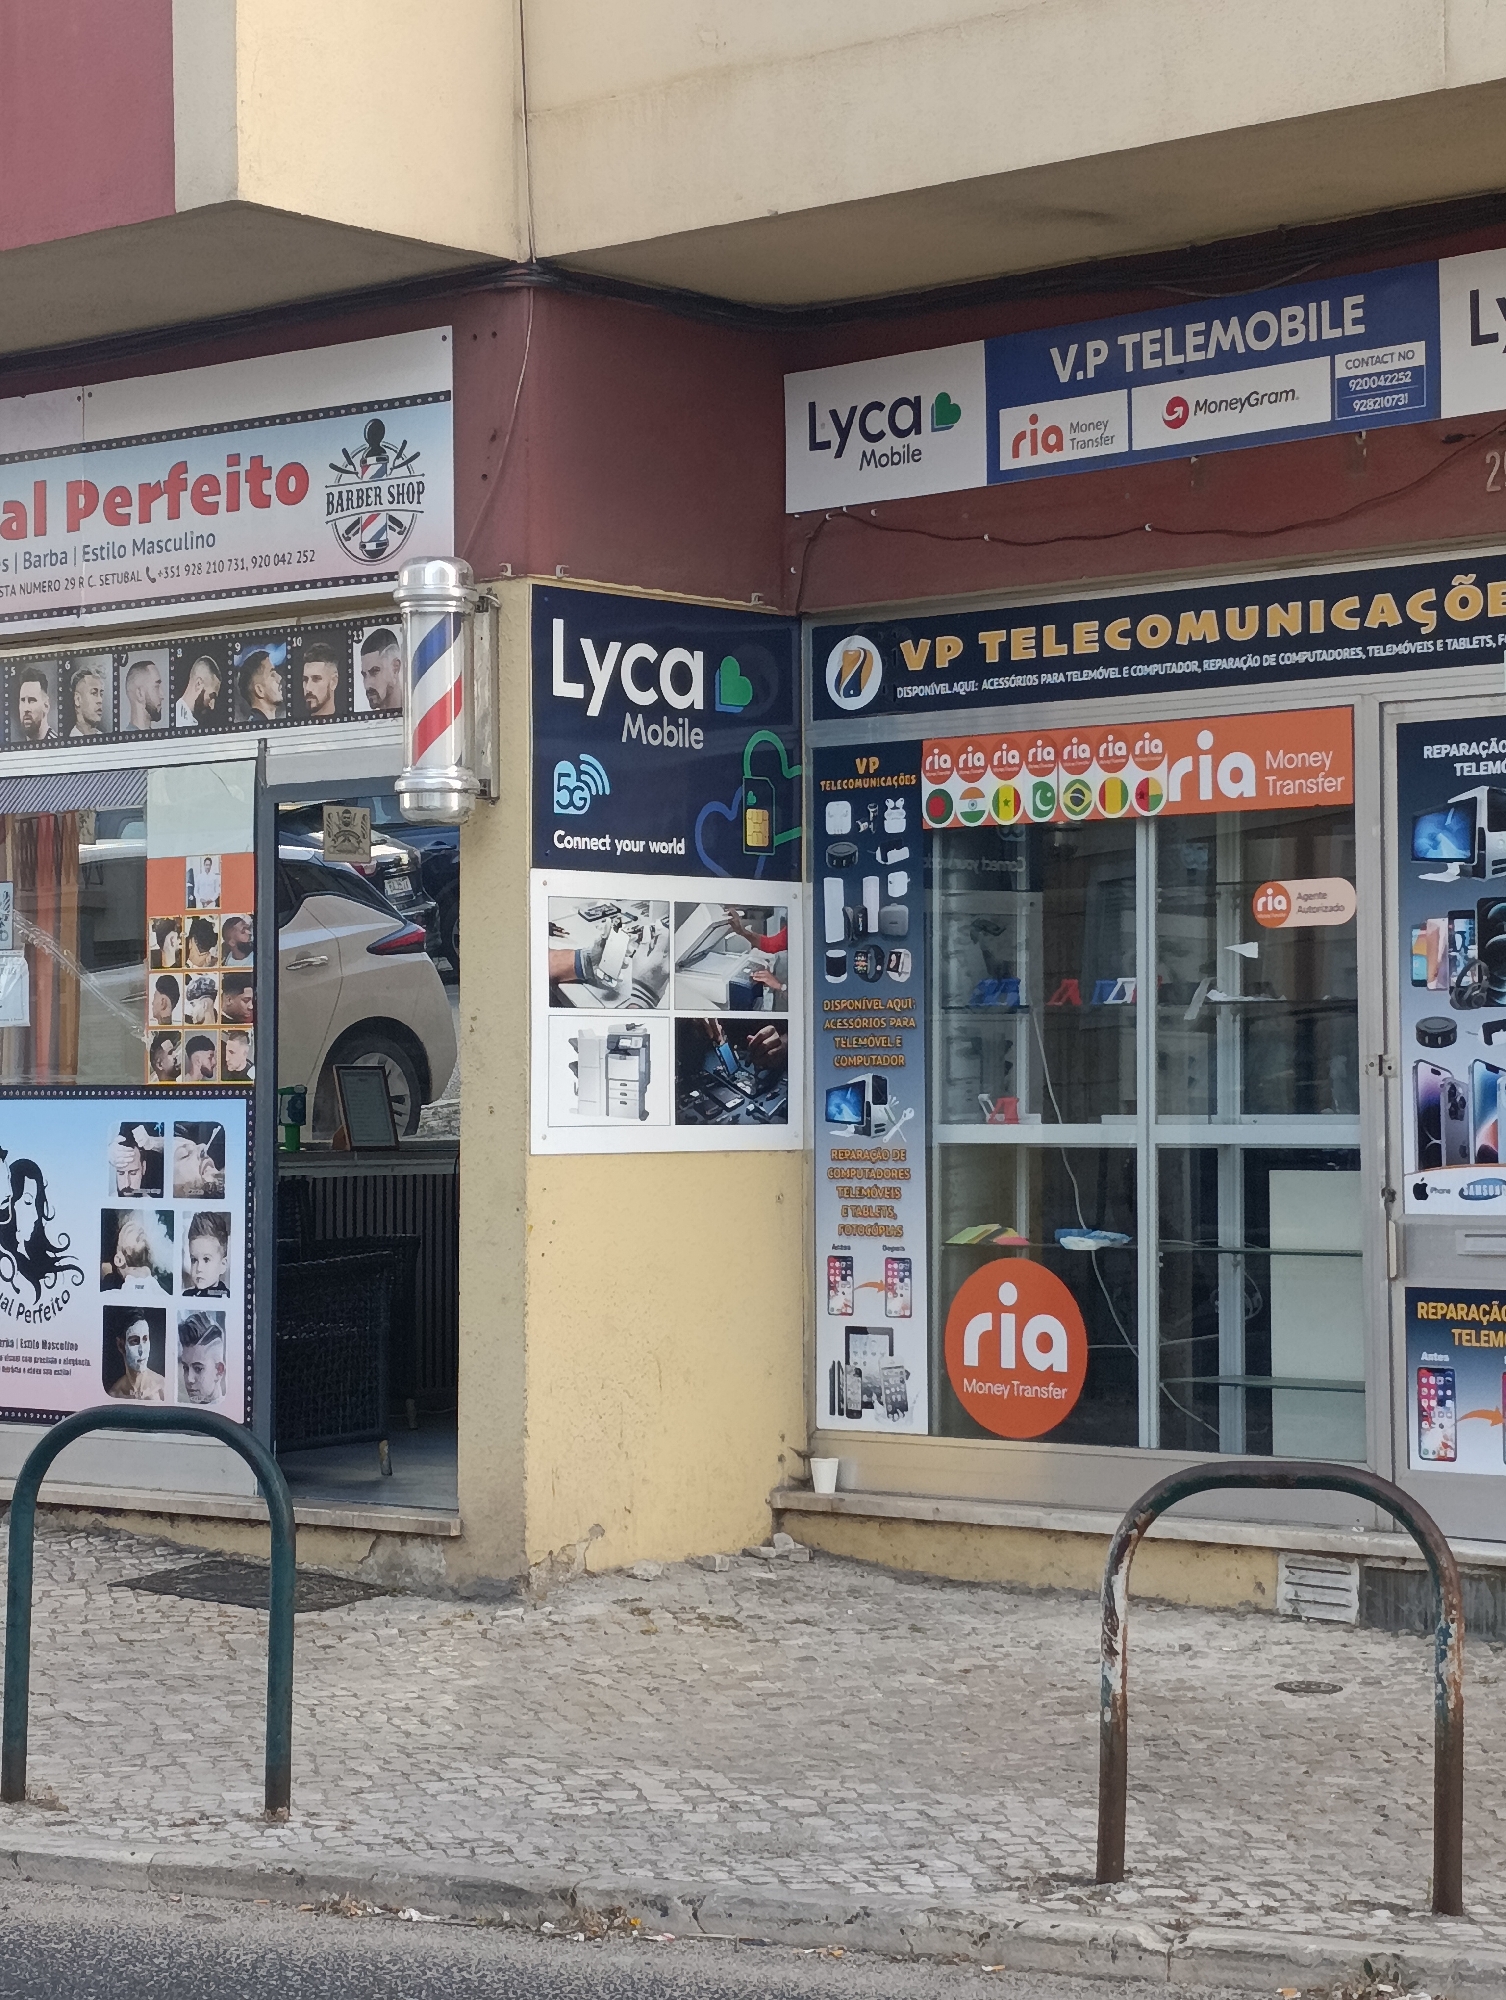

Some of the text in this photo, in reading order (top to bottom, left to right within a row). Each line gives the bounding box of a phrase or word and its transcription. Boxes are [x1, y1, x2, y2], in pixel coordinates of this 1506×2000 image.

[1050, 293, 1365, 383] V.P TELEMOBILE
[1345, 349, 1415, 370] CONTACT NO
[1349, 371, 1412, 391] 920042252
[1352, 392, 1409, 412] 928210731
[808, 395, 922, 459] Lyca
[1011, 413, 1064, 459] ria
[1069, 419, 1109, 434] Money
[1069, 434, 1115, 450] Transfer
[859, 444, 922, 471] Mobile
[1486, 451, 1506, 492] 2
[66, 453, 309, 533] Perfeito
[326, 480, 425, 516] BARBER SHOP
[23, 550, 68, 570] Barba
[82, 541, 127, 562] Estilo
[132, 531, 216, 557] Masculino
[19, 579, 60, 595] NUMERO
[64, 577, 76, 590] 29
[100, 570, 142, 587] SETUBAL
[158, 566, 181, 579] +351
[184, 563, 203, 577] 928
[206, 560, 225, 574] 210
[228, 558, 249, 571] 731,
[251, 555, 270, 568] 920
[273, 552, 292, 567] 042
[296, 550, 315, 563] 252
[235, 642, 241, 652] 9
[292, 636, 302, 647] 10
[353, 630, 363, 641] 11
[121, 654, 127, 664] 7
[899, 635, 964, 671] VP
[65, 661, 71, 670] 6
[552, 618, 704, 717] Lyca
[897, 682, 951, 698] DISPONÍVEL
[952, 680, 978, 695] AQUI:
[981, 674, 1039, 691] ACESSÓRIOS
[1041, 672, 1065, 684] PARA
[1066, 666, 1121, 682] TELEMÓVEL
[1123, 668, 1129, 677] E
[1130, 661, 1201, 677] COMPUTADOR,
[1203, 654, 1260, 671] REPARAÇÃO
[1263, 654, 1276, 666] DE
[1279, 647, 1366, 665] COMPUTADORES,
[1367, 640, 1434, 657] TELEMÓVEIS
[1437, 639, 1444, 651] E
[1445, 634, 1496, 651] TABLETS,
[621, 712, 704, 749] Mobile
[993, 743, 1020, 766] ria
[1028, 739, 1055, 762] ria
[1063, 737, 1091, 760] ria
[1099, 734, 1127, 758] ria
[1134, 731, 1163, 755] ria
[855, 756, 880, 774] VP
[925, 748, 951, 770] ria
[958, 745, 985, 768] ria
[1168, 729, 1256, 802] ria
[1265, 749, 1333, 771] Money
[555, 772, 591, 811] 5G
[820, 773, 917, 791] TELECOMUNICAÇÕES
[1265, 772, 1345, 796] Transfer
[553, 829, 685, 855] Connect your world
[1257, 888, 1287, 911] ria
[1296, 892, 1327, 902] Agente
[1297, 903, 1345, 914] Autorizado
[823, 997, 884, 1011] DISPONÍVEL
[824, 1015, 916, 1029] ACESSÓRIOS PARA
[834, 1034, 902, 1048] TELEMÓVEL E
[834, 1054, 905, 1067] COMPUTADOR
[831, 1147, 906, 1164] REPARAÇÃO DE
[827, 1167, 911, 1180] COMPUTADORES
[836, 1184, 902, 1199] TELEMÓVEIS
[16, 1290, 71, 1324] Perfeito
[964, 1281, 1068, 1373] ria
[1420, 1351, 1450, 1362] Antes
[964, 1377, 1068, 1399] Money Transfer
